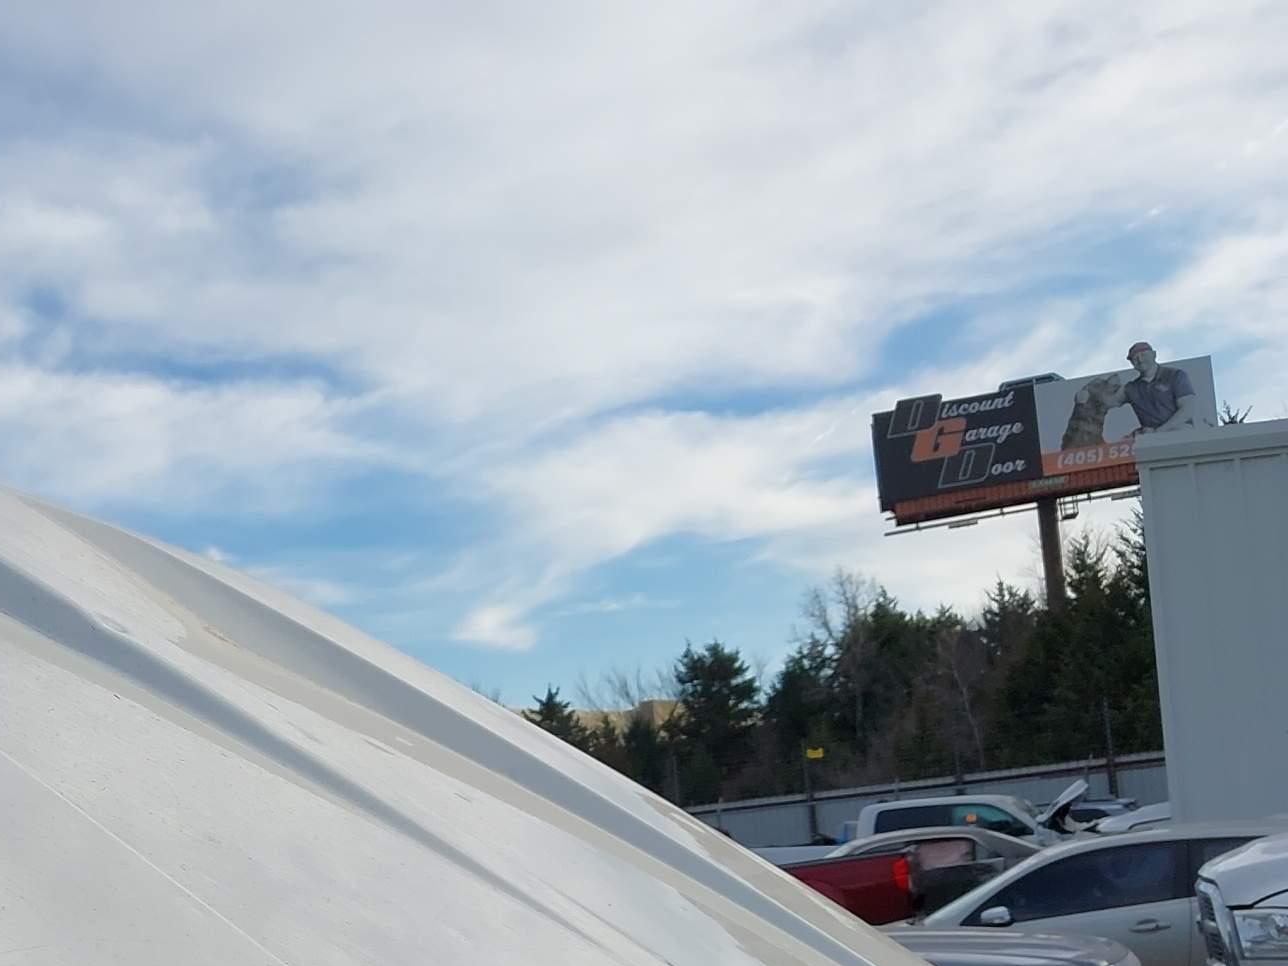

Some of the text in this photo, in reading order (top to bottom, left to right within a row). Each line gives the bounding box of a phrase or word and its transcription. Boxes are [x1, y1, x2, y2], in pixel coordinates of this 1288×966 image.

[887, 391, 1015, 438] Discount
[910, 417, 1024, 464] Garage
[1057, 447, 1104, 469] (405)
[938, 442, 1027, 489] Door
